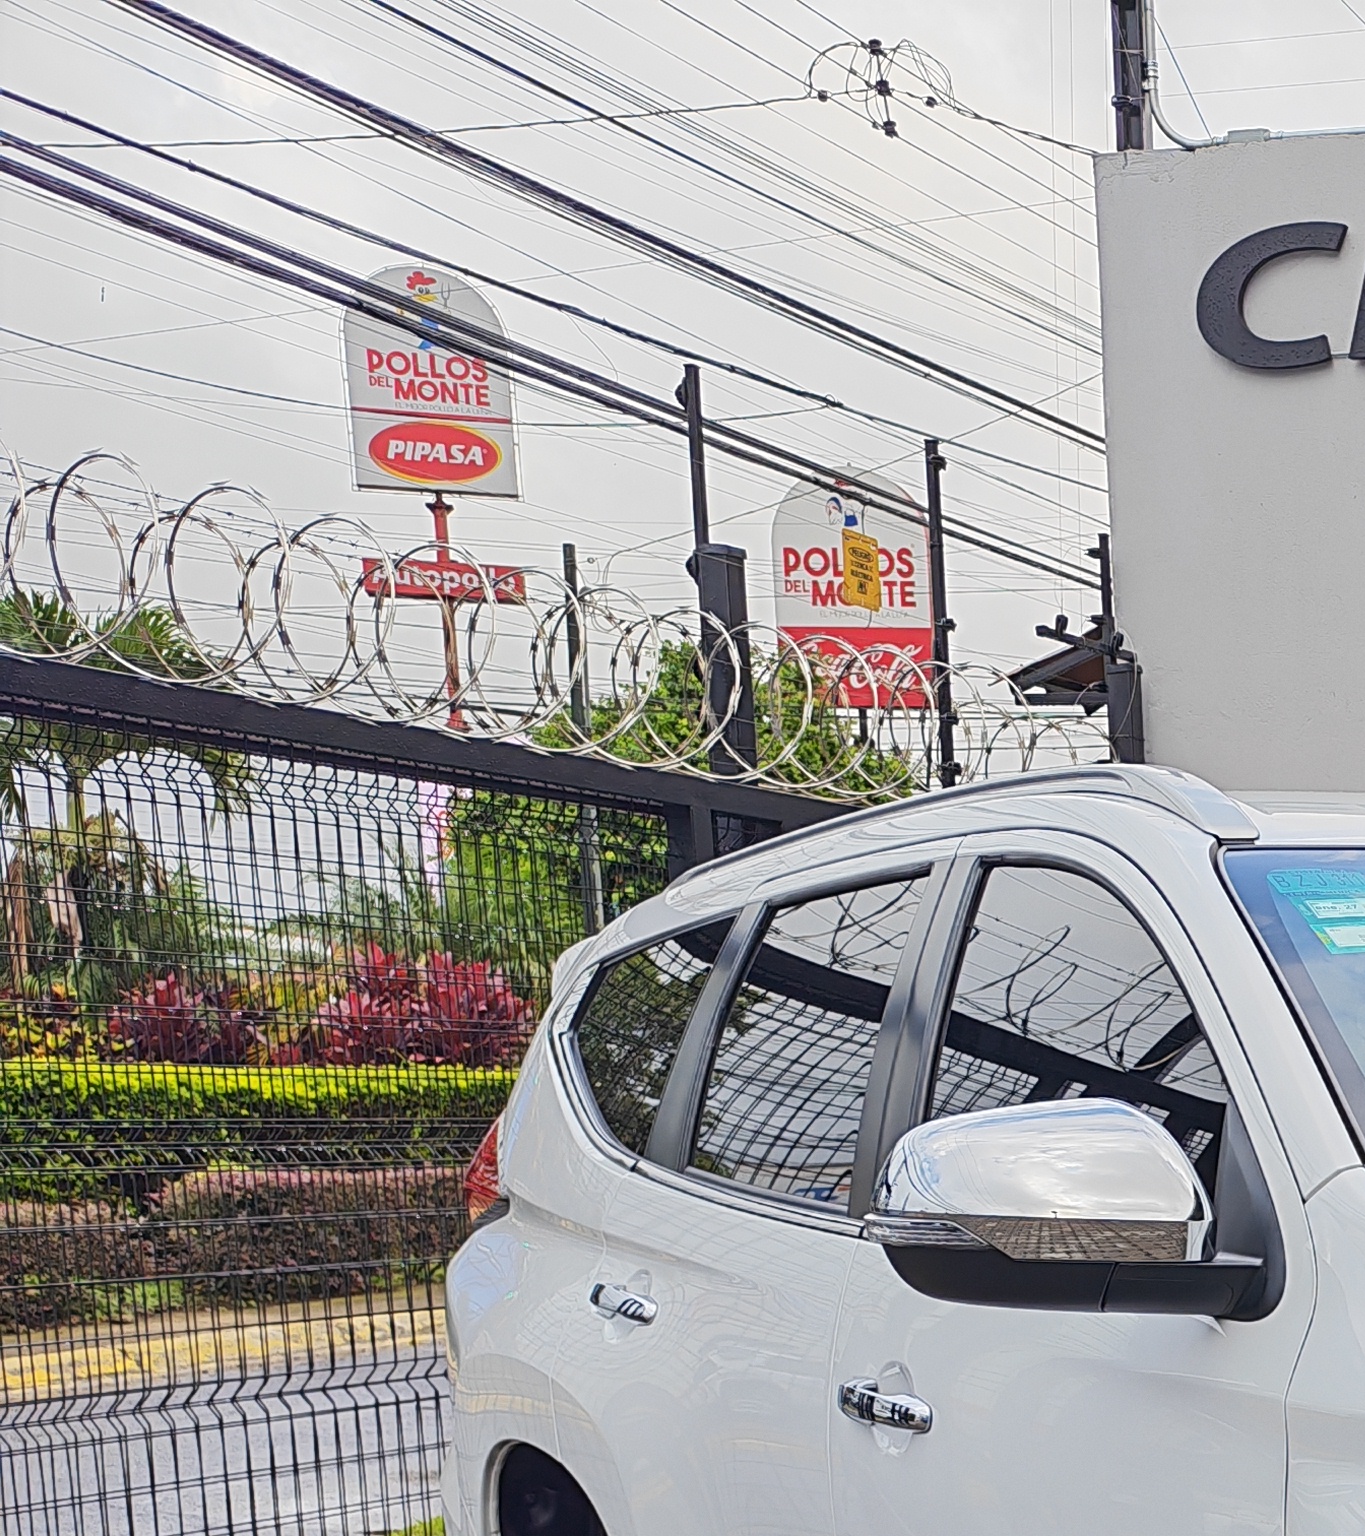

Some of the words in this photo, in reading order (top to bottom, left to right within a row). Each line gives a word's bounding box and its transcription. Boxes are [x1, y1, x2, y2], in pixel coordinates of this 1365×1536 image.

[366, 348, 489, 383] POLLOS
[369, 376, 393, 388] DEL
[394, 377, 491, 407] MONTE
[386, 439, 485, 466] PIPASA
[783, 547, 915, 578] POLOS
[785, 579, 810, 593] DEL
